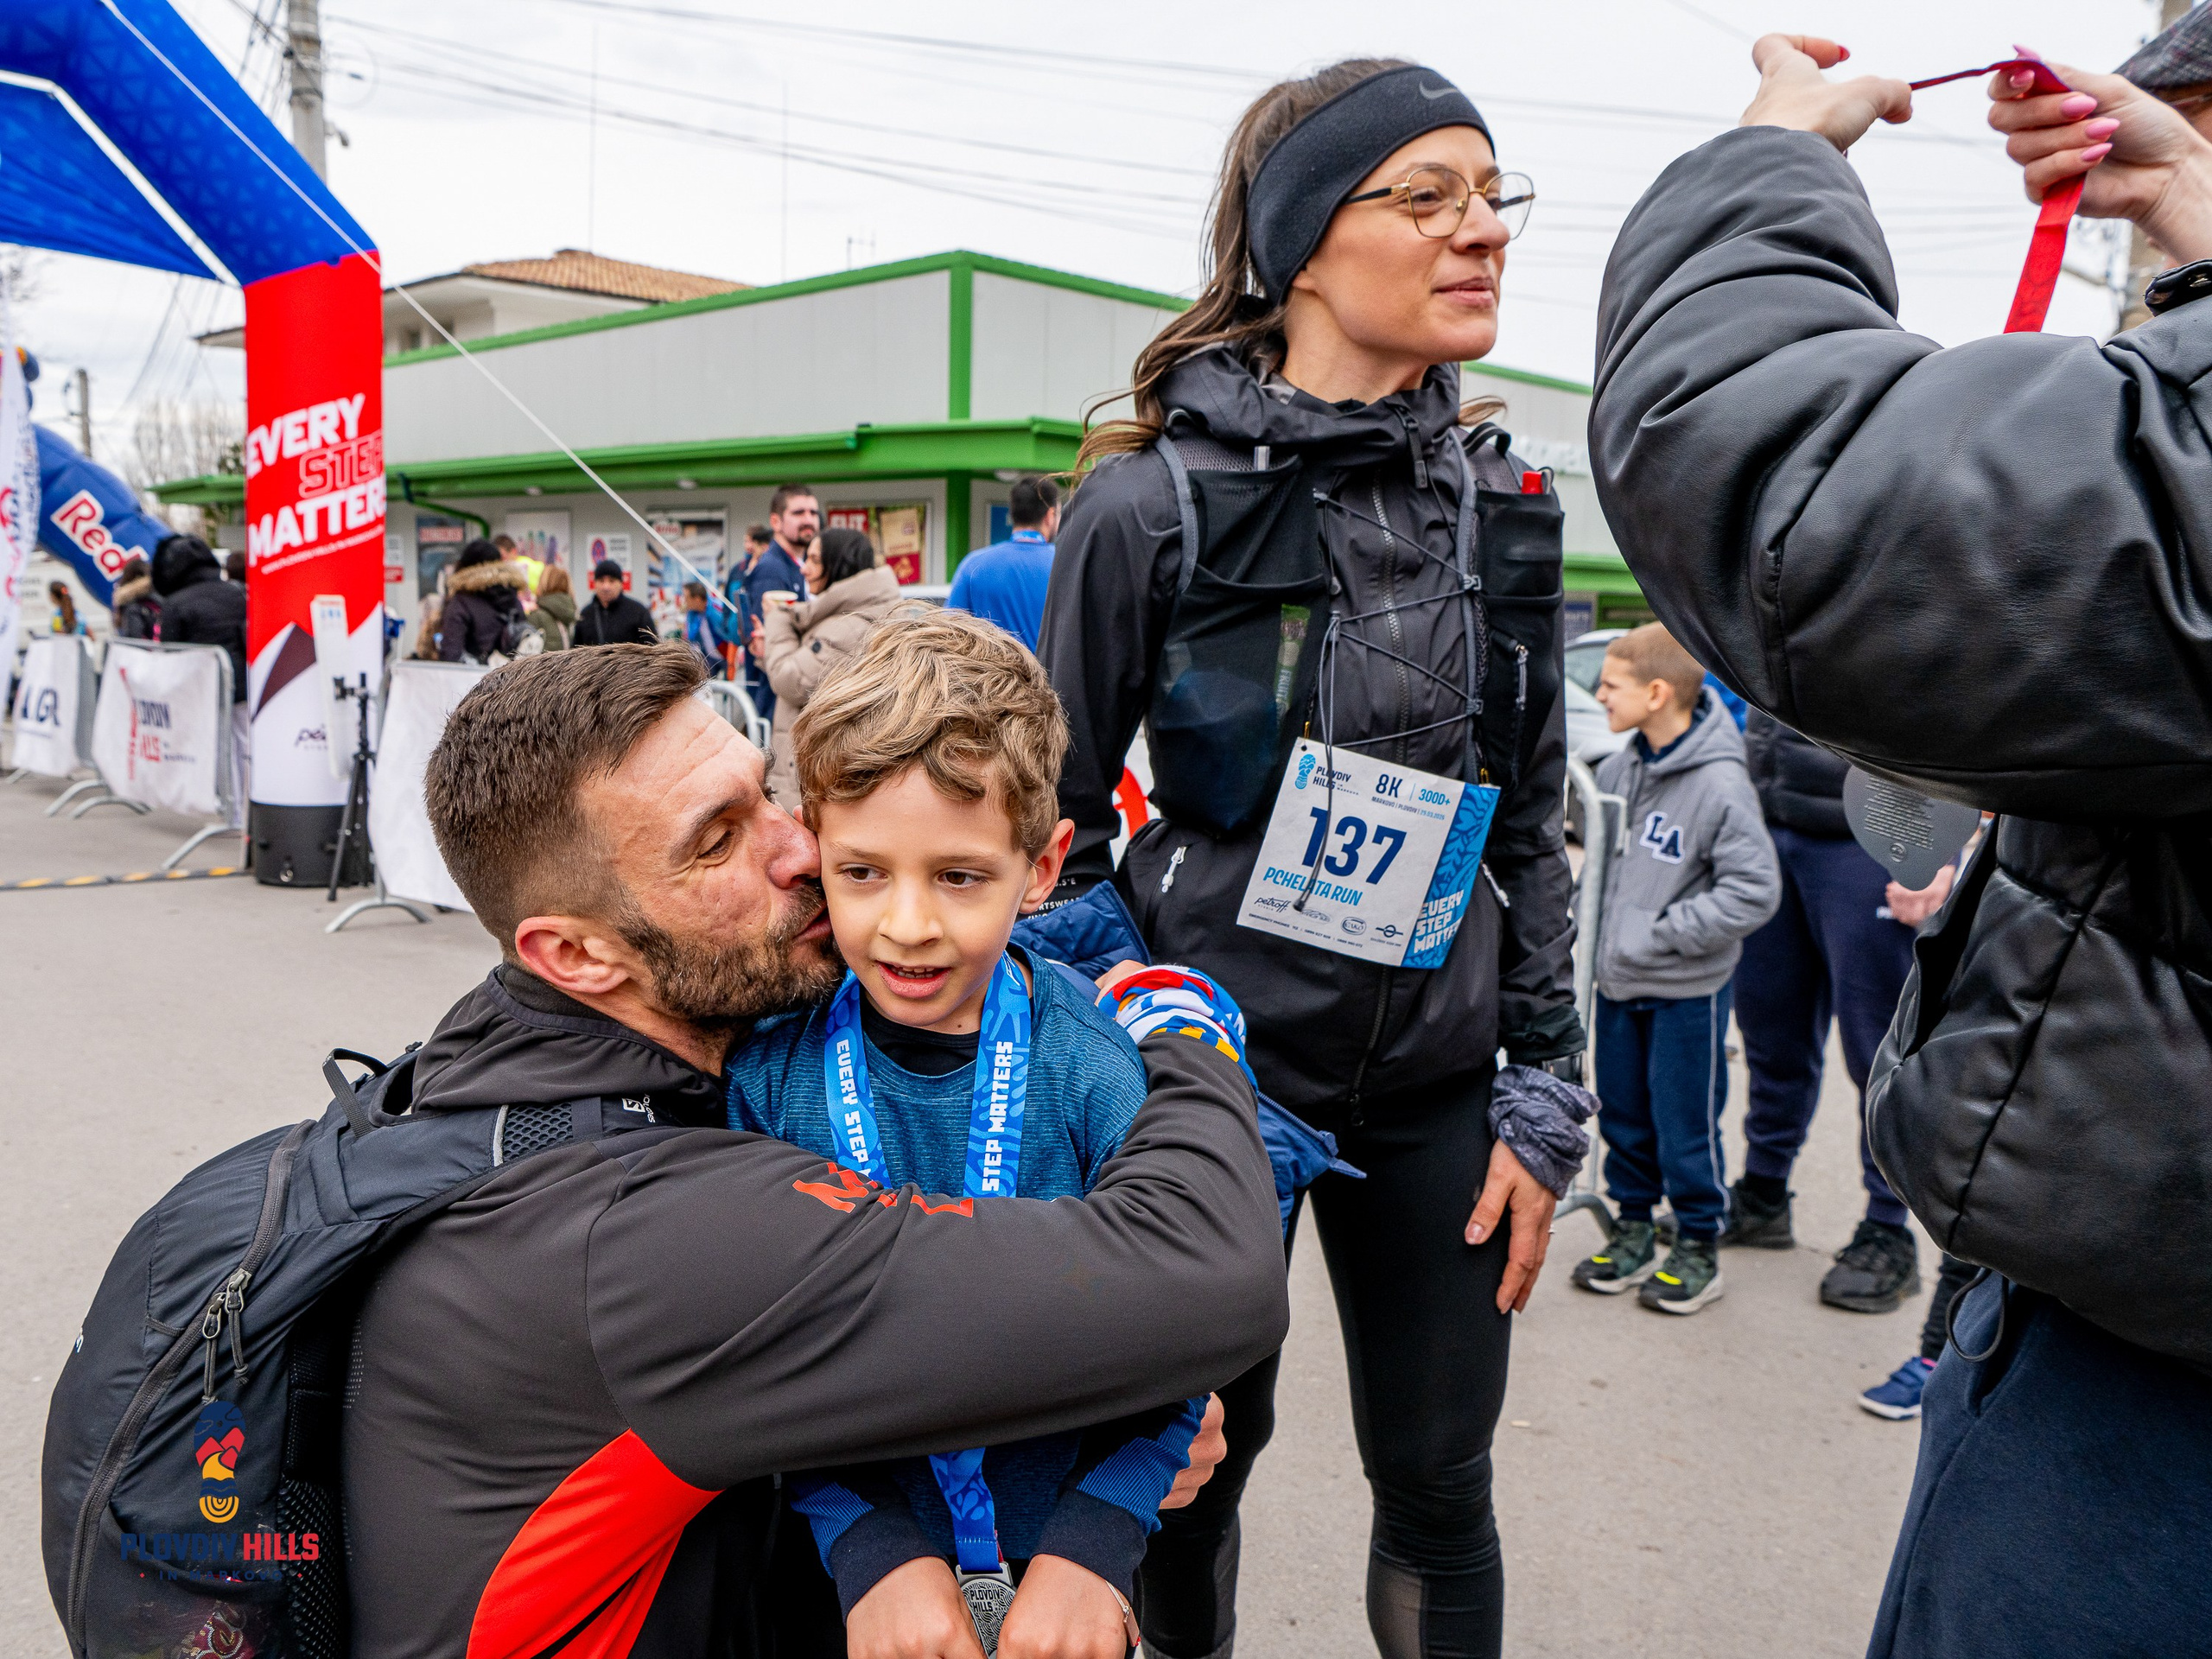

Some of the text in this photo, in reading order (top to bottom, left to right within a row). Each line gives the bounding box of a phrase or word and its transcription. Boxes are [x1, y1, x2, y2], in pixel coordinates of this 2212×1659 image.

[245, 392, 365, 480] EVERY
[54, 493, 146, 578] Red
[247, 474, 386, 569] MATTER
[1376, 773, 1403, 798] 8K
[1418, 788, 1451, 806] 300D+
[1301, 806, 1408, 886] 137
[1643, 813, 1682, 861] LA
[1254, 897, 1292, 913] petroff
[1331, 885, 1363, 906] RUN
[1415, 910, 1453, 937] STEP
[982, 1040, 1014, 1192] STEP MATTERS
[844, 1110, 869, 1164] STEP
[969, 1589, 1001, 1600] PLOVDIV
[972, 1601, 994, 1612] HILLS
